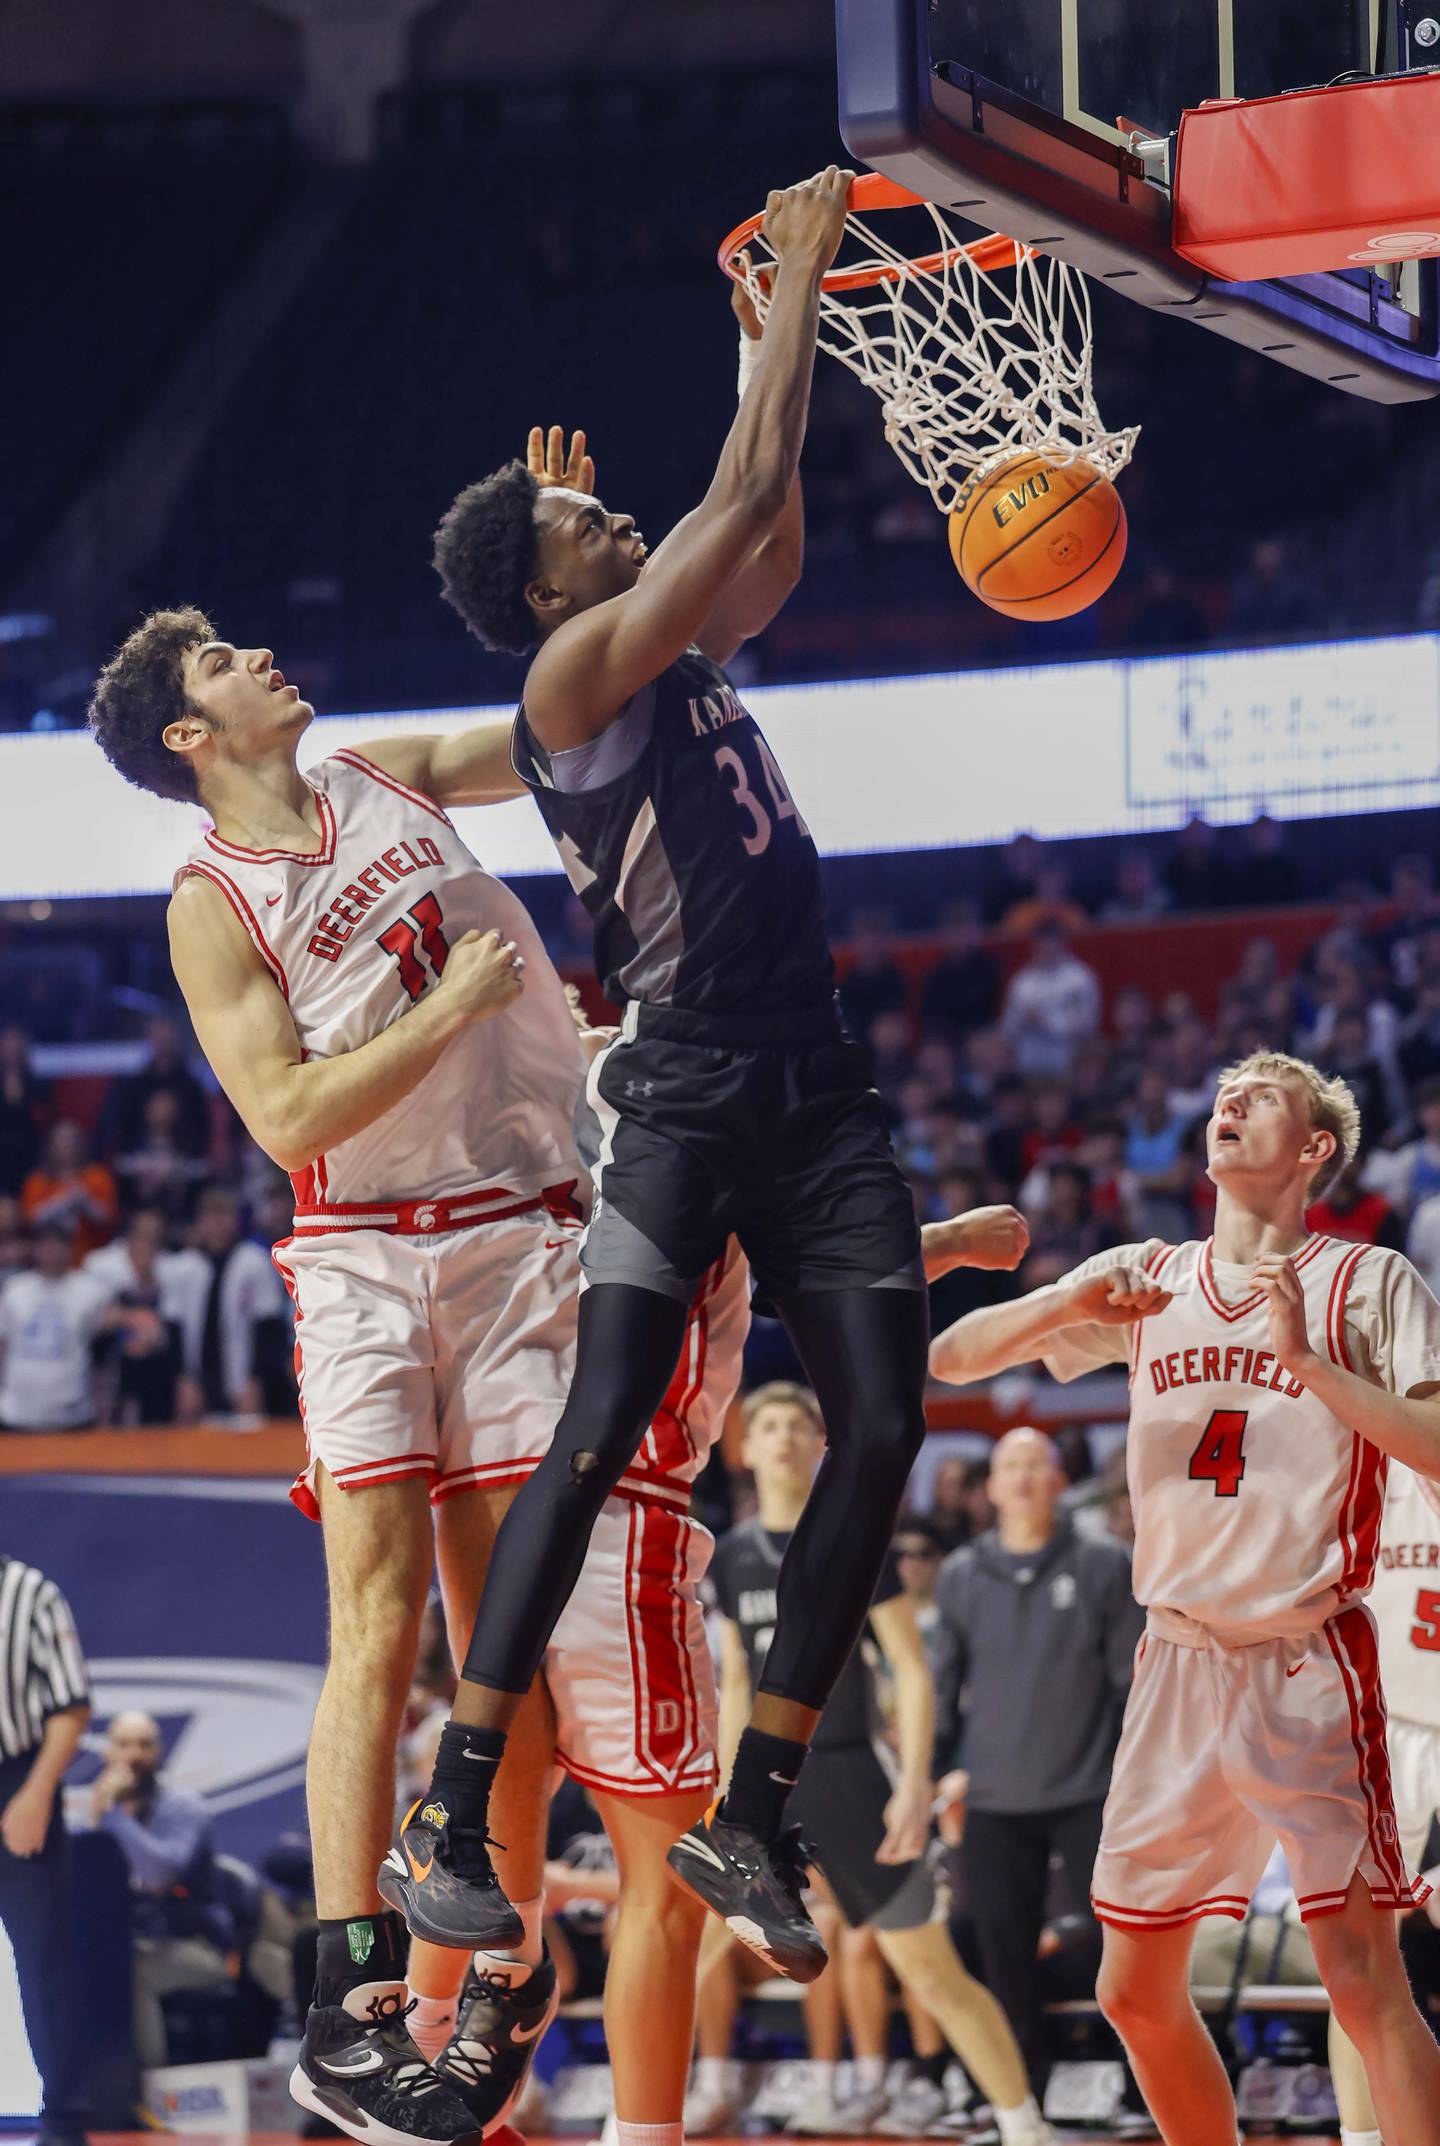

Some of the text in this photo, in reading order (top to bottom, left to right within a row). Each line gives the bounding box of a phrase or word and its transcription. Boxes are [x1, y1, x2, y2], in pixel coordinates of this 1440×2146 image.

[992, 471, 1050, 529] EVO
[714, 733, 810, 856] 34
[306, 837, 446, 963] DEERFIELD
[375, 890, 449, 1003] 11
[1149, 1346, 1305, 1399] DEERFIELD
[1188, 1409, 1248, 1497] 4
[1409, 1588, 1440, 1653] 5
[655, 1700, 680, 1735] D
